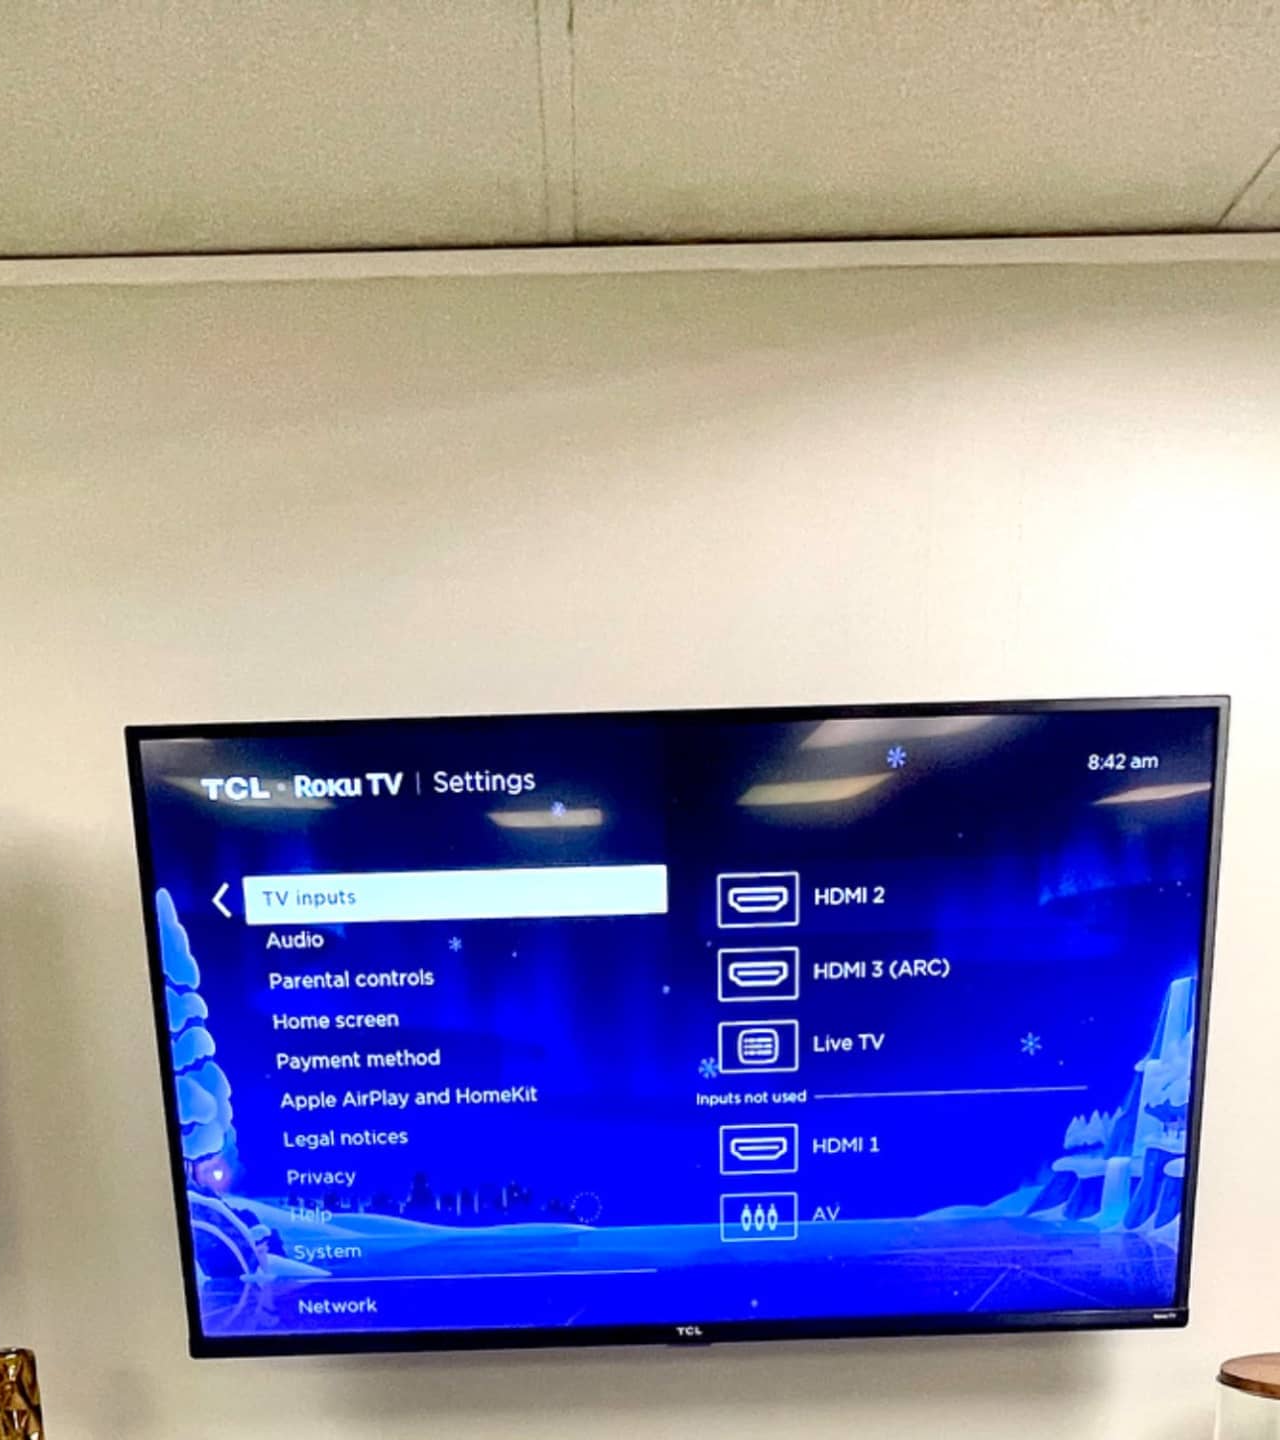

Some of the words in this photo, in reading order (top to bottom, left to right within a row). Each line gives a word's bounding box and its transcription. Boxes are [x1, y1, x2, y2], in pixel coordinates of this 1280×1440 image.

[1087, 754, 1127, 771] 8:42
[1131, 755, 1159, 769] am
[201, 777, 270, 800] TCL
[294, 774, 361, 797] Roku
[367, 773, 403, 796] TV
[433, 770, 536, 795] Settings
[262, 890, 288, 906] TV
[296, 888, 357, 908] inputs
[814, 888, 867, 905] HDMI
[872, 887, 885, 904] 2
[267, 931, 324, 949] Audio
[813, 962, 868, 981] HDMI
[872, 961, 884, 979] 3
[889, 957, 951, 980] (ARC)
[269, 970, 349, 990] Parental
[355, 968, 434, 988] controls
[273, 1012, 330, 1030] Home
[335, 1011, 400, 1028] screen
[813, 1035, 854, 1053] Live
[859, 1033, 886, 1051] TV
[276, 1051, 361, 1073] Payment
[366, 1049, 441, 1068] method
[281, 1090, 337, 1112] Apple
[342, 1088, 409, 1109] AirPlay
[414, 1087, 450, 1105] and
[455, 1085, 538, 1104] HomeKit
[695, 1092, 741, 1108] Inputs
[744, 1091, 768, 1105] not
[772, 1089, 807, 1104] used
[283, 1130, 335, 1150] Legal
[340, 1129, 409, 1147] notices
[813, 1138, 864, 1154] HDMI
[869, 1136, 880, 1153] 1
[287, 1169, 357, 1187] Privacy
[289, 1205, 333, 1225] Help
[813, 1205, 840, 1222] AV
[294, 1243, 362, 1262] System
[298, 1297, 378, 1315] Network
[675, 1326, 703, 1337] TCL
